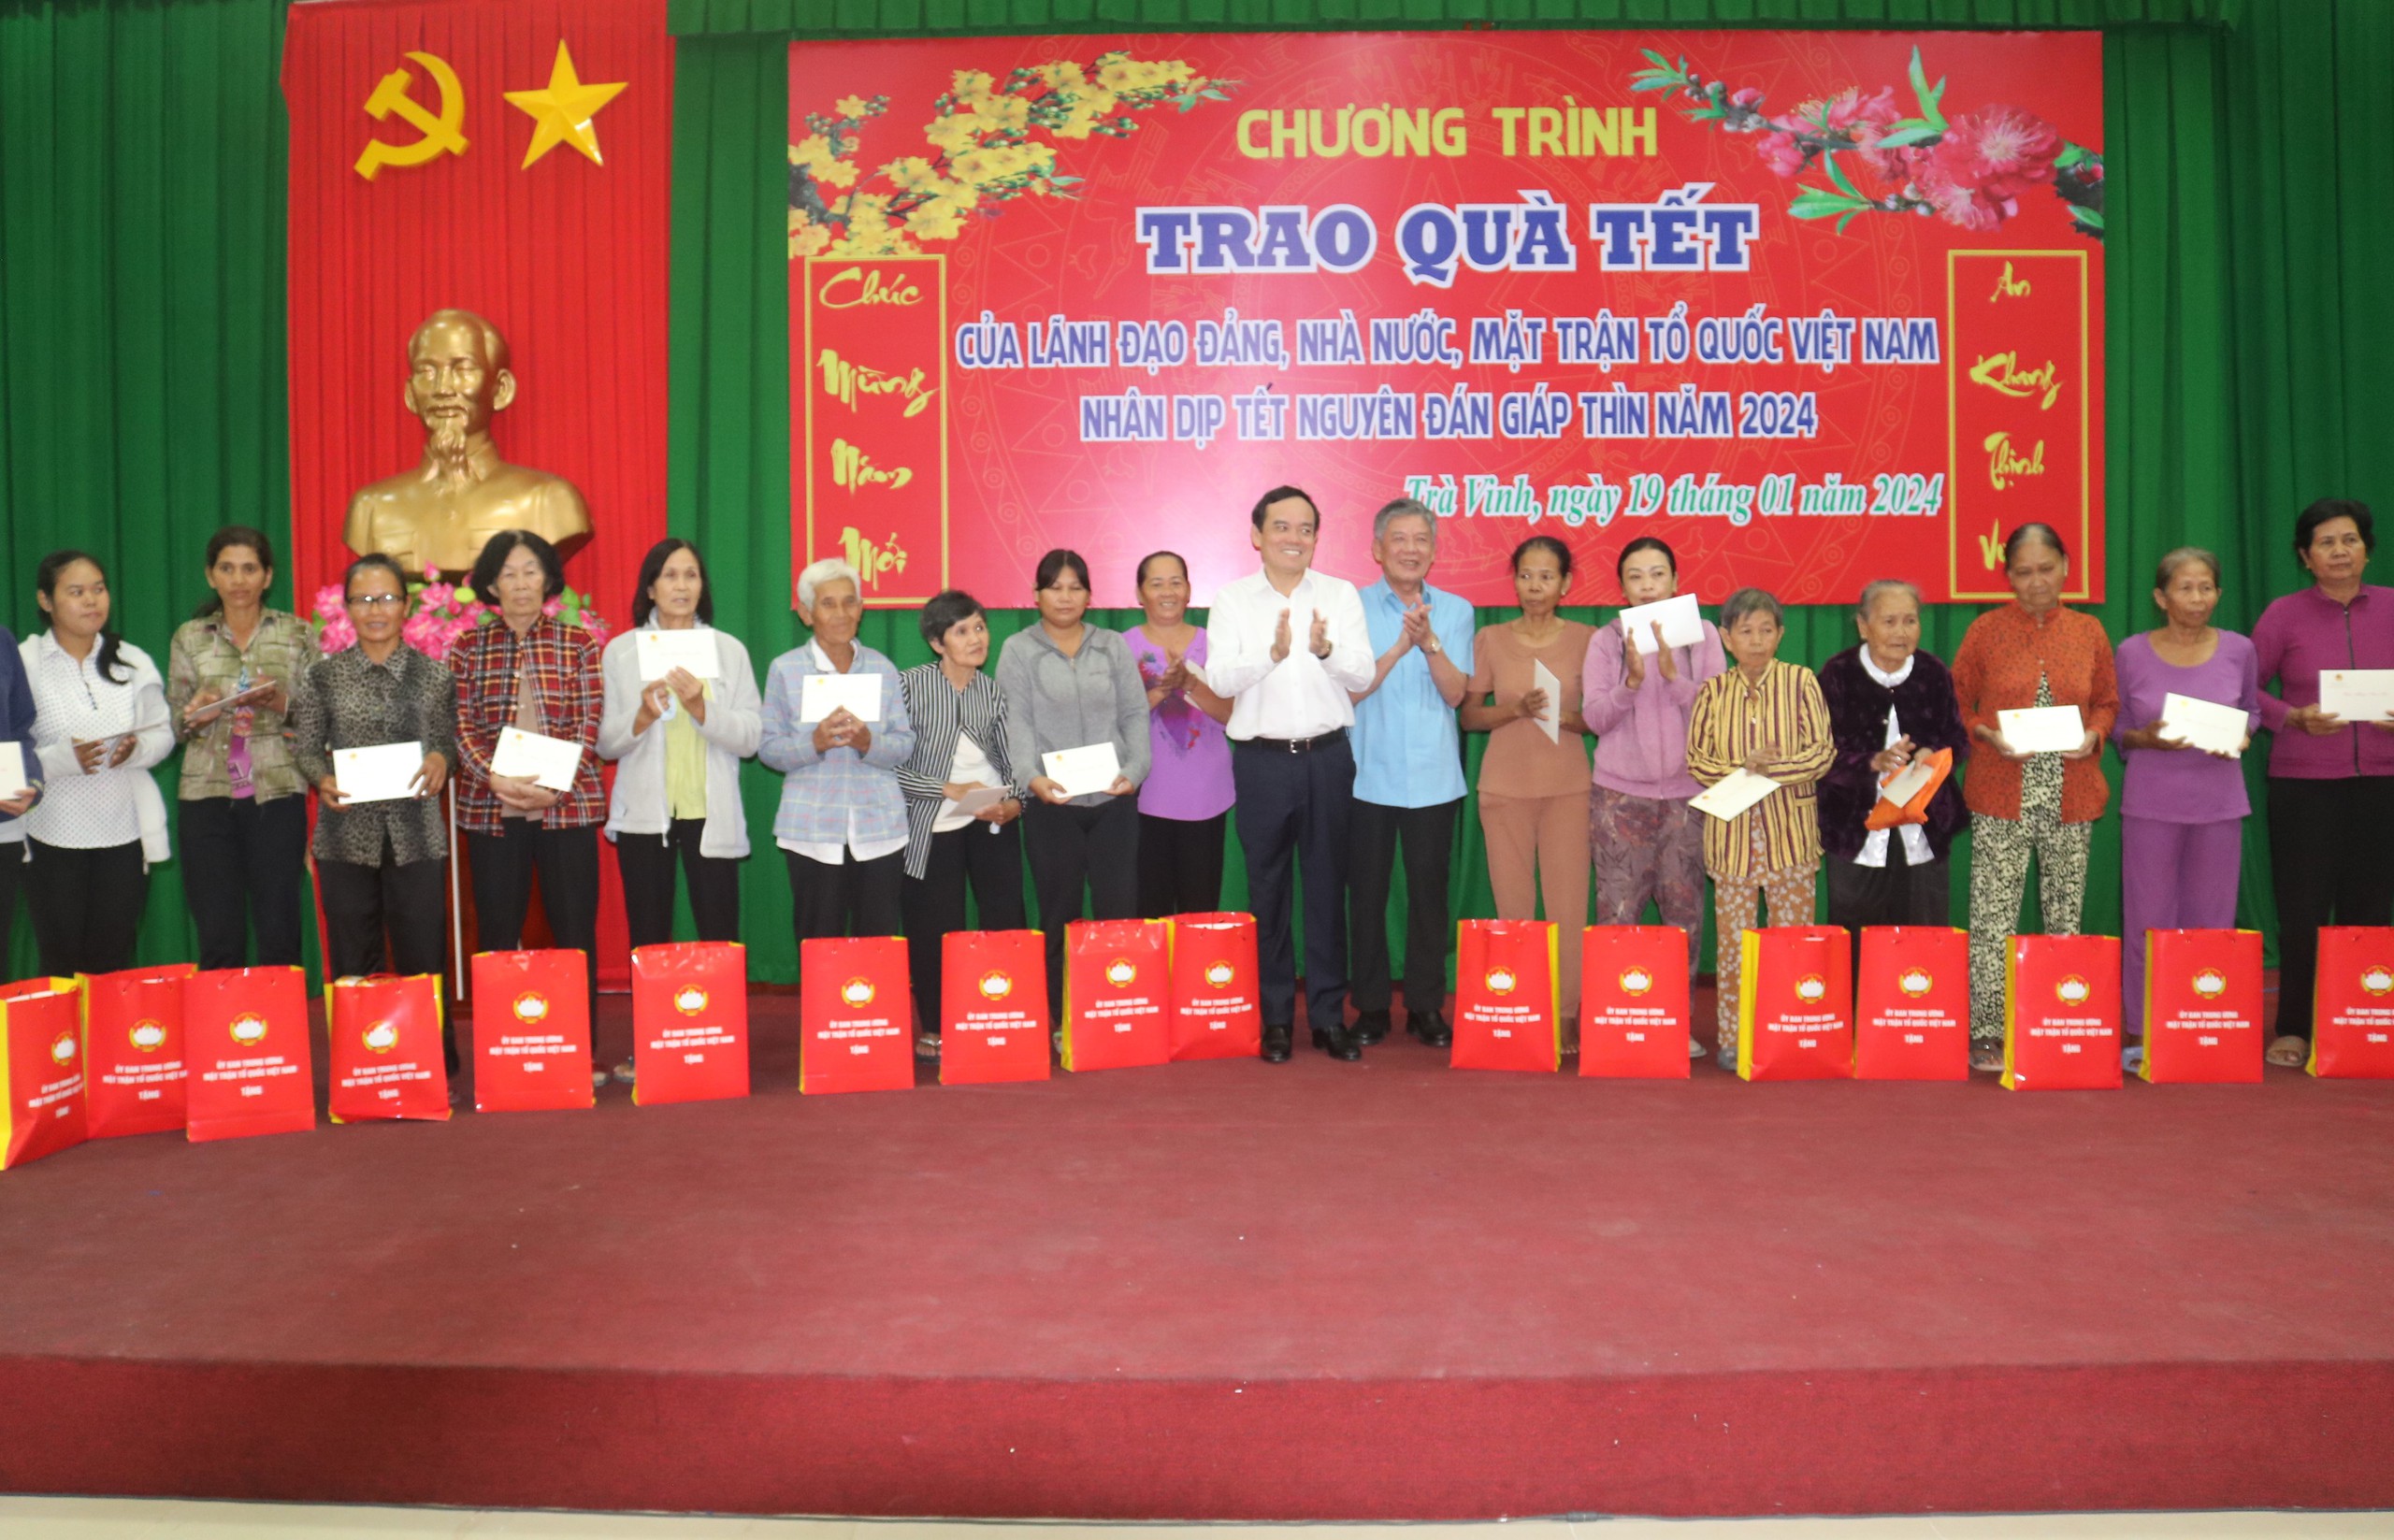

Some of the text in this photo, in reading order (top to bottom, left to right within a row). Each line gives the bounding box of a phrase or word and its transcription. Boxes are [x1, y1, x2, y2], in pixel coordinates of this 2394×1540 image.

[1236, 95, 1657, 158] CHƯƠNG TRÌNH
[1136, 182, 1759, 289] TRAO QUÀ TẾT
[819, 266, 924, 309] Chúc
[1989, 261, 2031, 303] An
[956, 301, 1940, 375] CỦA LÃNH ĐẠO ĐẢNG, NHÀ NƯỚC, MẶT TRẬN TỔ QUỐC VIỆT NAM
[1080, 382, 1818, 448] NHÂN DỊP TẾT NGUYÊN ĐÁN GIÁP THÌN NĂM 2024
[1405, 472, 1944, 526] Trà Vinh, ngày 19 tháng 01 năm 2024
